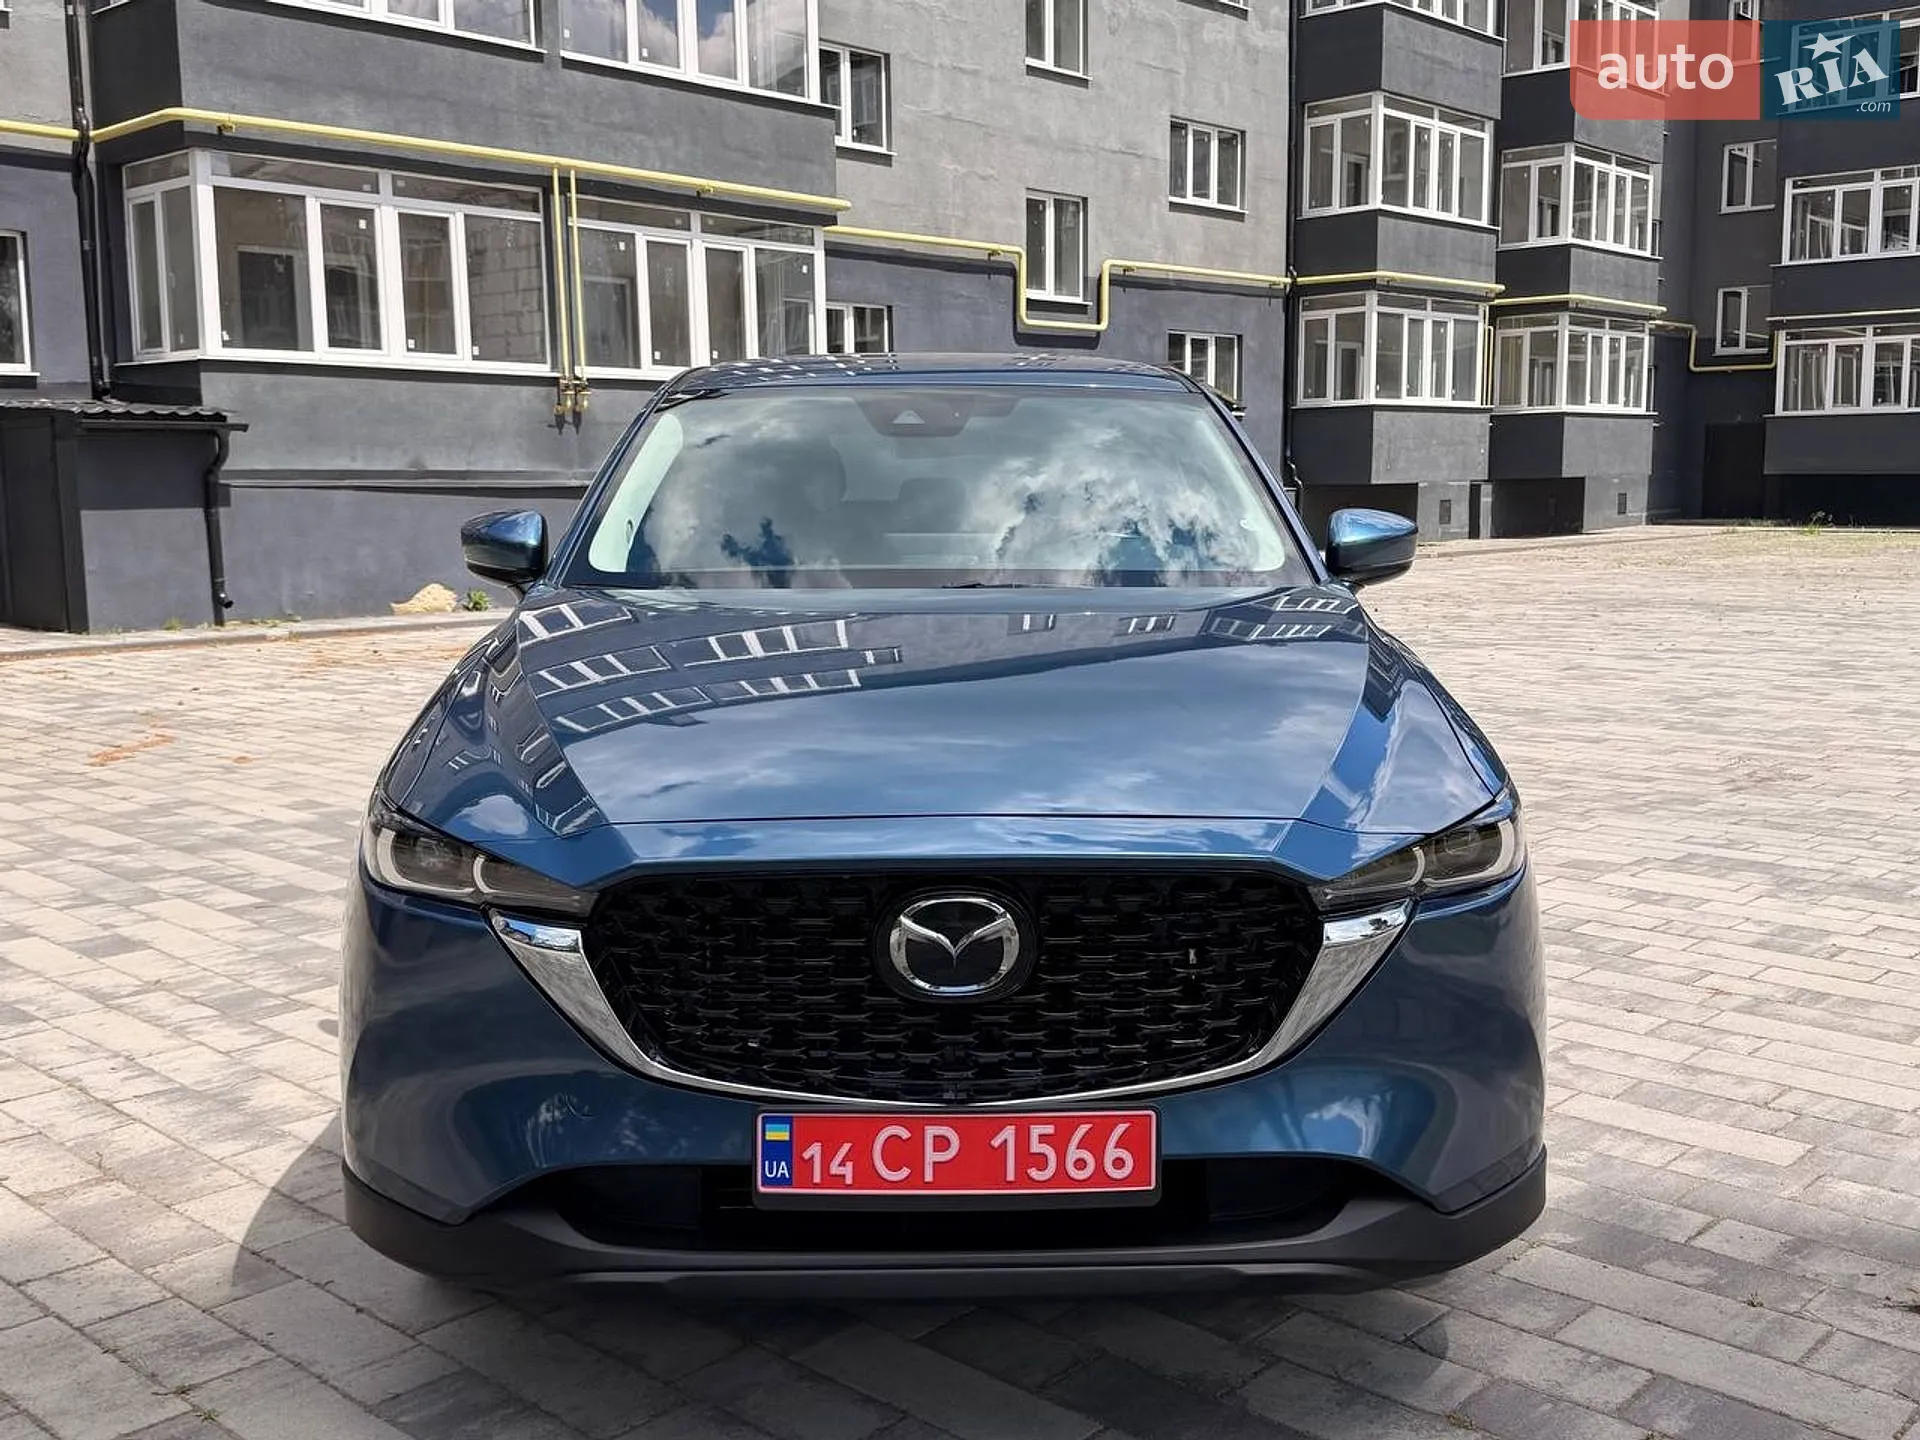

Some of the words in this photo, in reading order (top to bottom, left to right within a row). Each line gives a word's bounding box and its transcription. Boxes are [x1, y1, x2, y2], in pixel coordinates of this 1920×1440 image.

[765, 1160, 789, 1178] UA
[802, 1141, 853, 1185] 14
[872, 1124, 960, 1183] CP
[990, 1122, 1135, 1182] 1566
